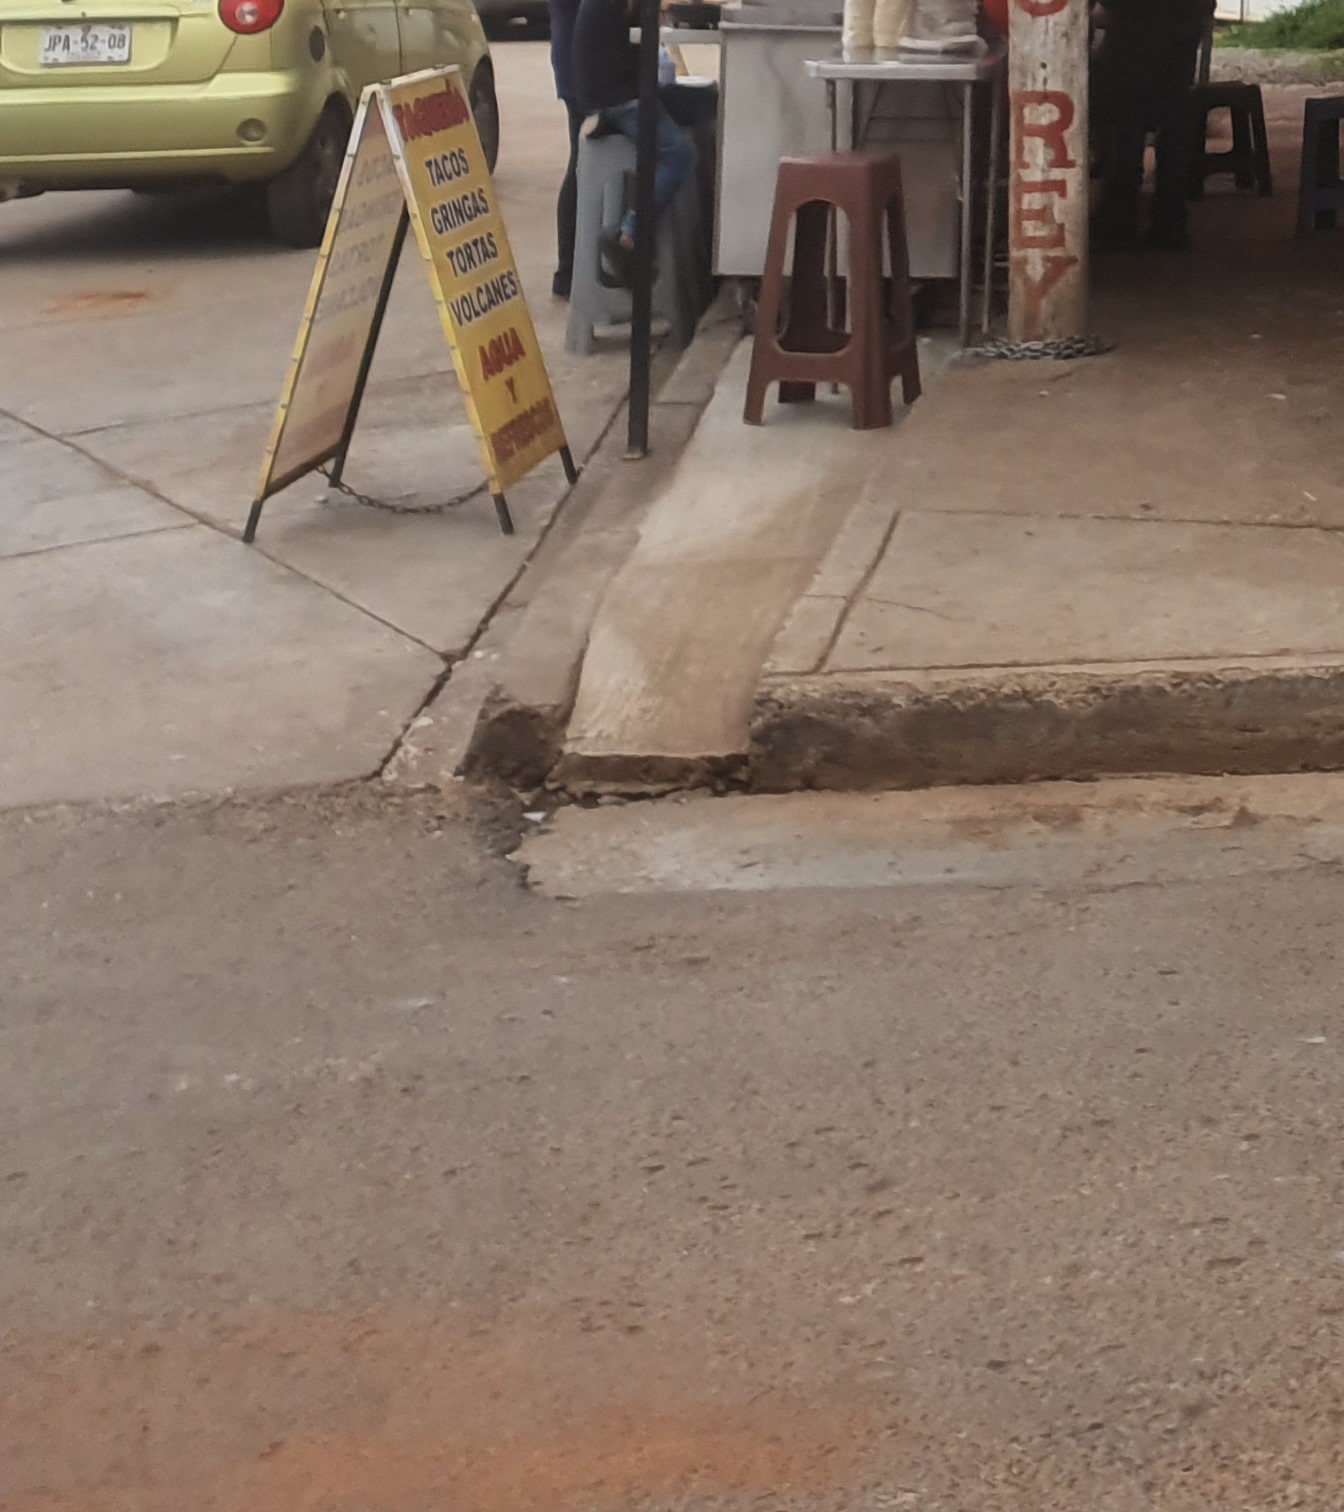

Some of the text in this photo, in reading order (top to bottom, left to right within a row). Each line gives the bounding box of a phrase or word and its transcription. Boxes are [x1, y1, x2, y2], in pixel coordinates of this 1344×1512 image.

[424, 147, 470, 187] TACOS
[431, 187, 490, 235] GRINGAS
[1011, 90, 1078, 338] REY
[446, 231, 498, 278] TORTAS
[450, 270, 519, 327] VOLCANES
[505, 376, 518, 404] Y
